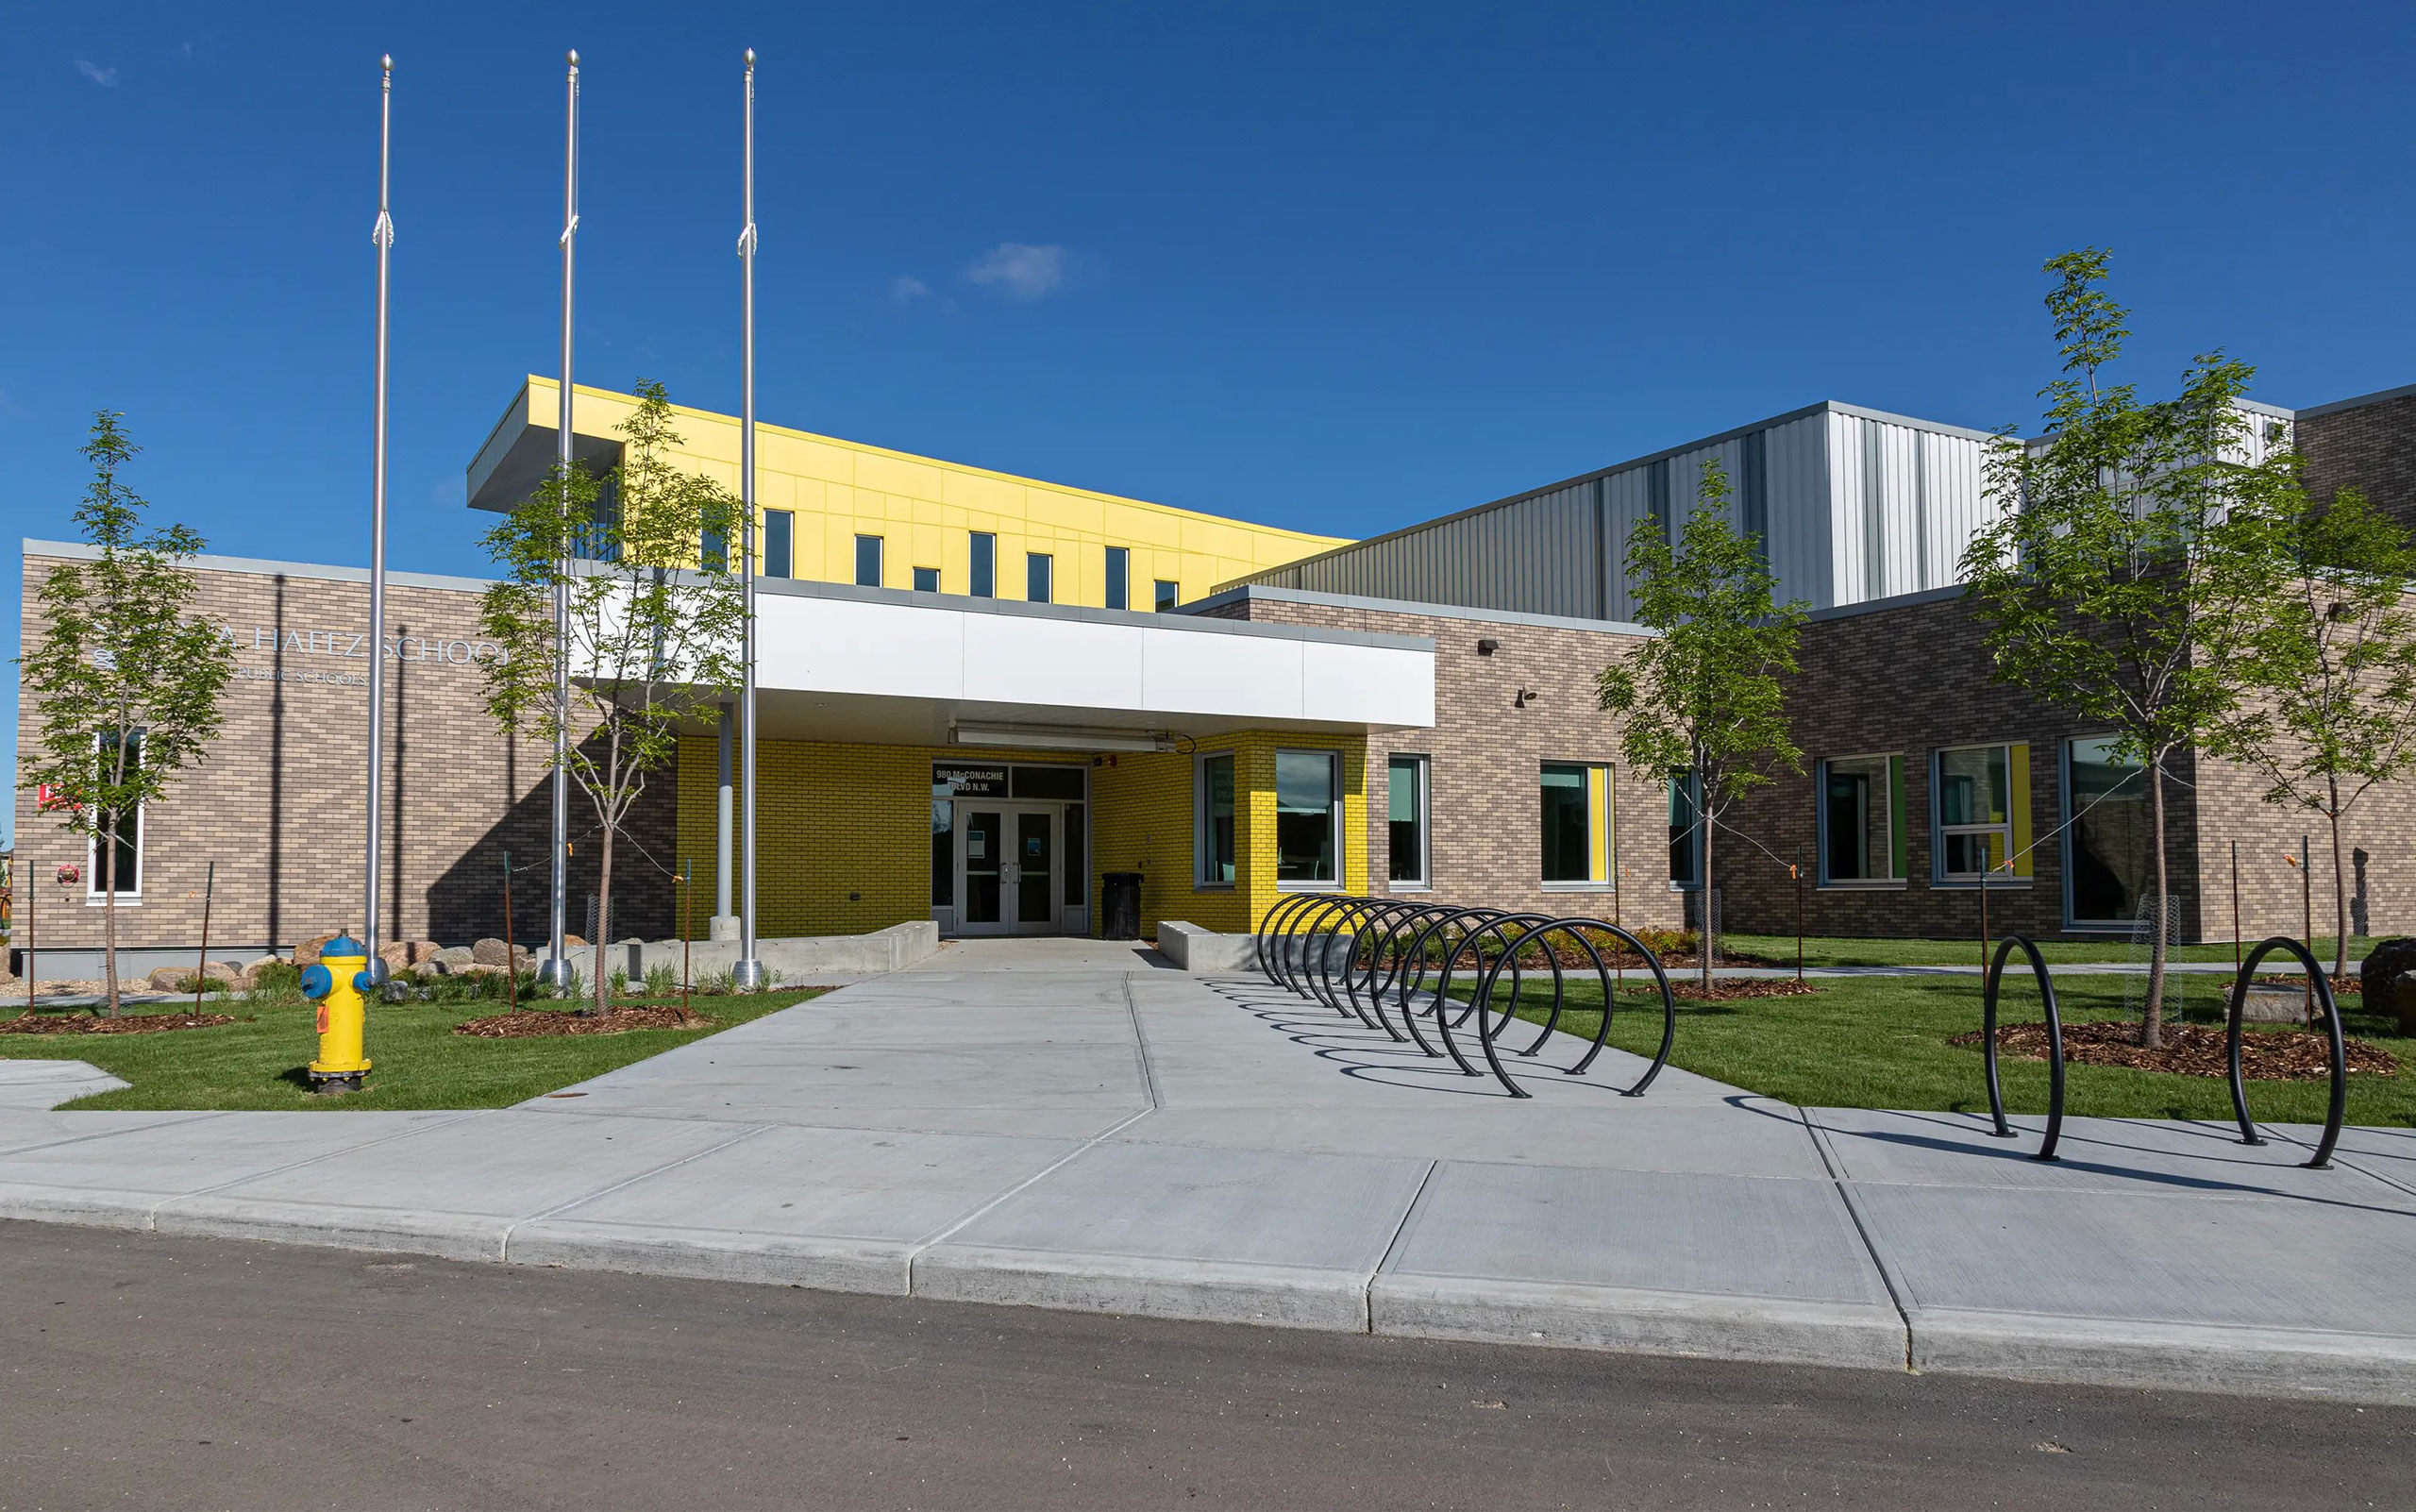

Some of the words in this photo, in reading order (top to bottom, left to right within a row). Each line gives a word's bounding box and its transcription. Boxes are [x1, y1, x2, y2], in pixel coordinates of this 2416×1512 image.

[254, 627, 364, 658] HAFEZ
[237, 667, 292, 681] PUBLIC
[295, 670, 366, 686] SCHOOLS
[936, 770, 951, 779] 980
[952, 770, 1004, 781] McCONACHIE
[972, 782, 990, 792] N.W.
